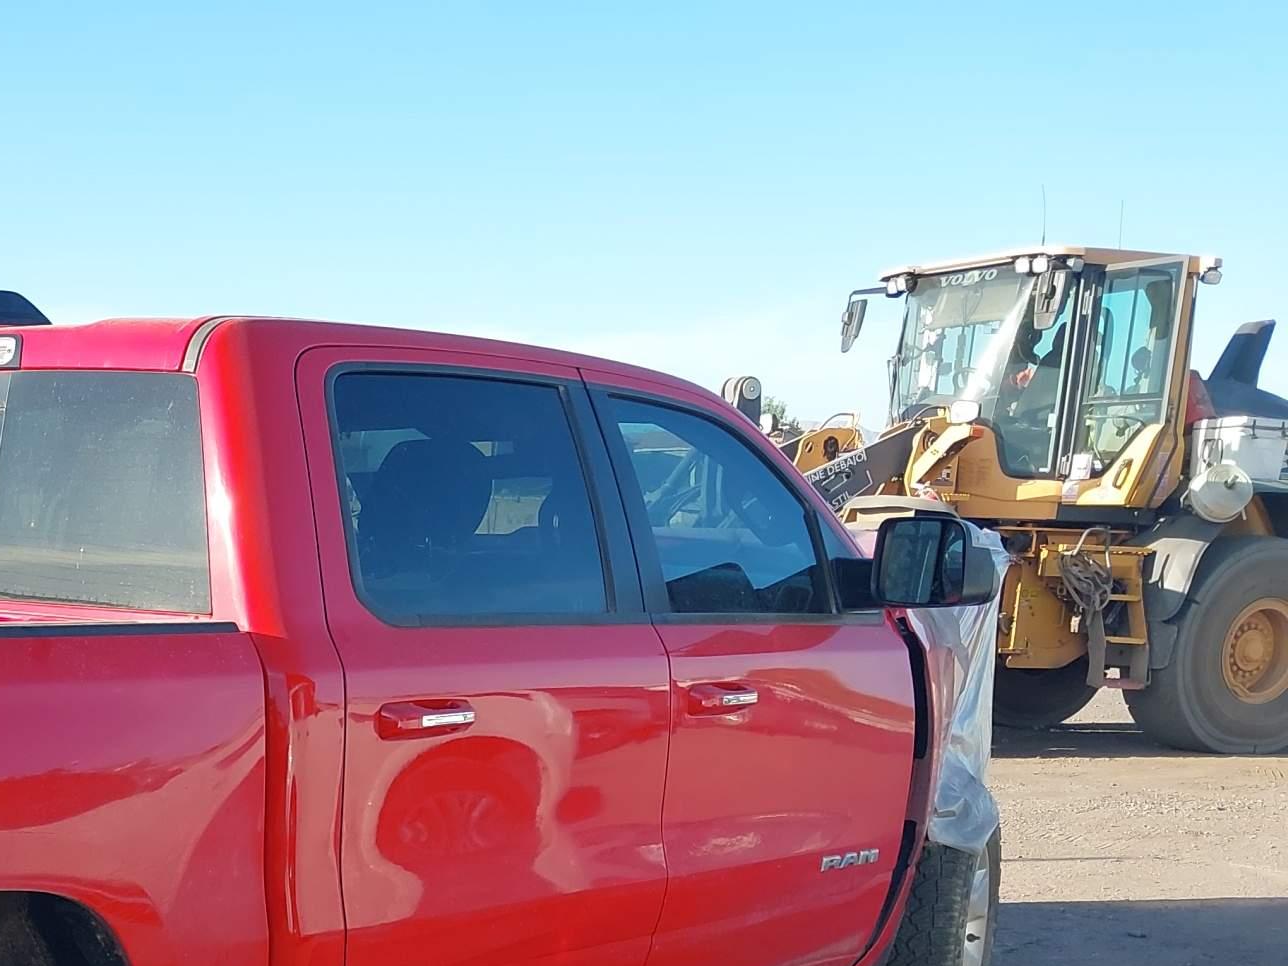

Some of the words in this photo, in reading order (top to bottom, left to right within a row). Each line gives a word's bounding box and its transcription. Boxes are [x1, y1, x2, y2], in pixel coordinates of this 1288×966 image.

[940, 269, 998, 288] VOLVO
[826, 452, 864, 477] DEBAJO
[820, 847, 880, 872] RAM
